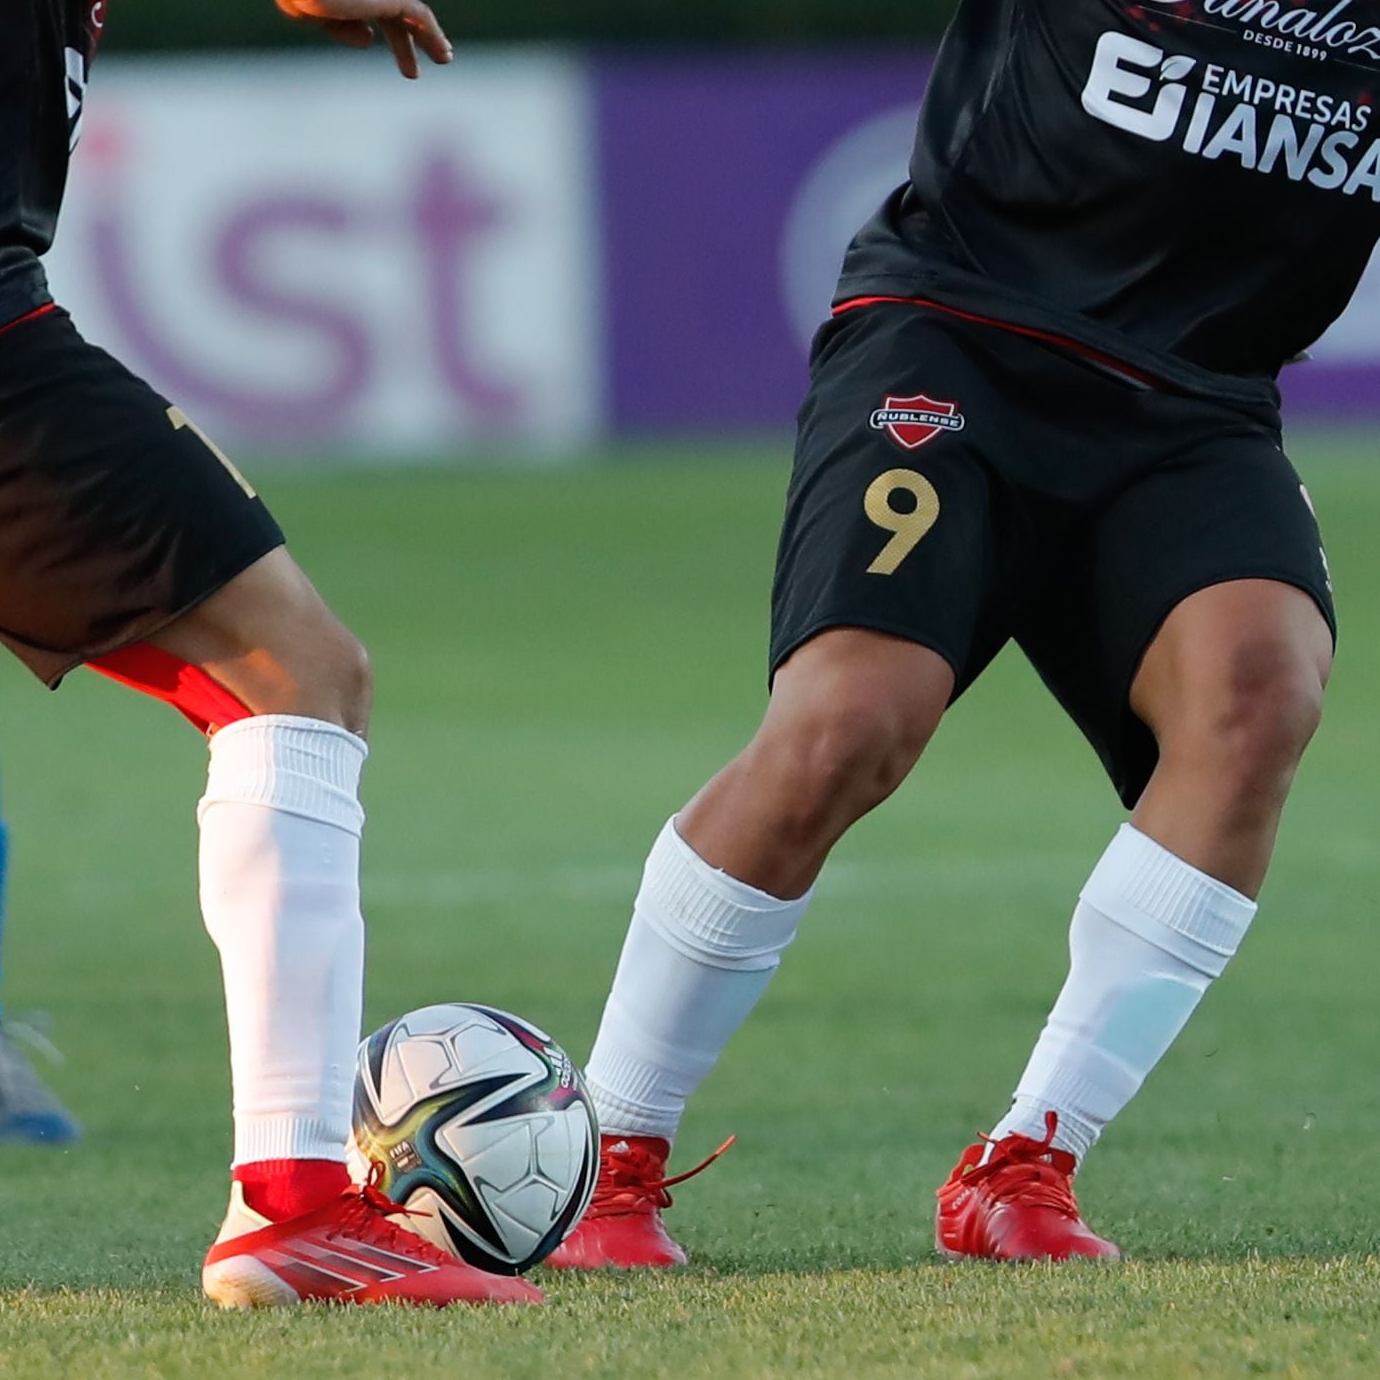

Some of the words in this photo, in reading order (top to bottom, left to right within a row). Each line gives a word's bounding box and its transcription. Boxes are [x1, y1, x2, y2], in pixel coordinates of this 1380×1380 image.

[1243, 28, 1294, 54] DESDE
[1296, 43, 1328, 62] 1899
[1202, 64, 1372, 133] EMPRESAS
[863, 468, 940, 576] 9
